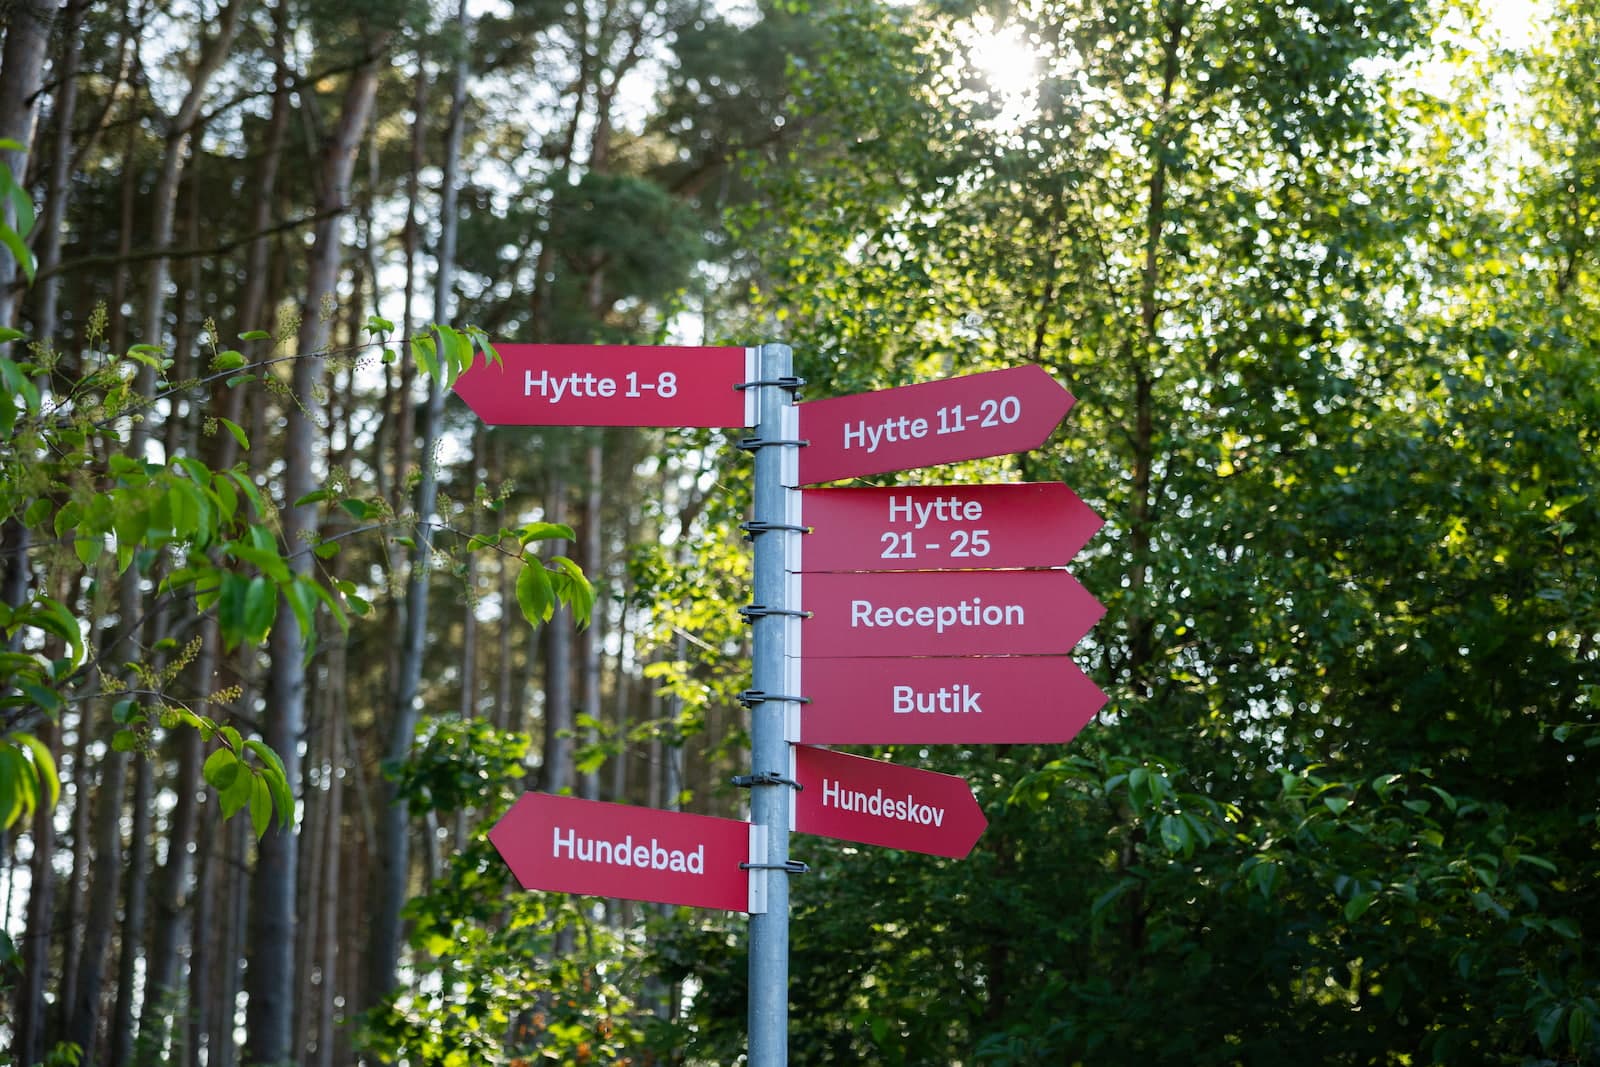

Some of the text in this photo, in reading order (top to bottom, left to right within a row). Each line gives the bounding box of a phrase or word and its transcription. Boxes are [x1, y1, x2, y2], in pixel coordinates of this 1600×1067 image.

[523, 369, 617, 404] Hytte
[843, 415, 929, 453] Hytte
[889, 495, 984, 530] Hytte
[880, 531, 917, 559] 21
[949, 529, 991, 558] 25
[851, 597, 1025, 633] Reception
[893, 683, 983, 714] Butik
[822, 778, 945, 828] Hundeskov
[553, 826, 704, 875] Hundebad
